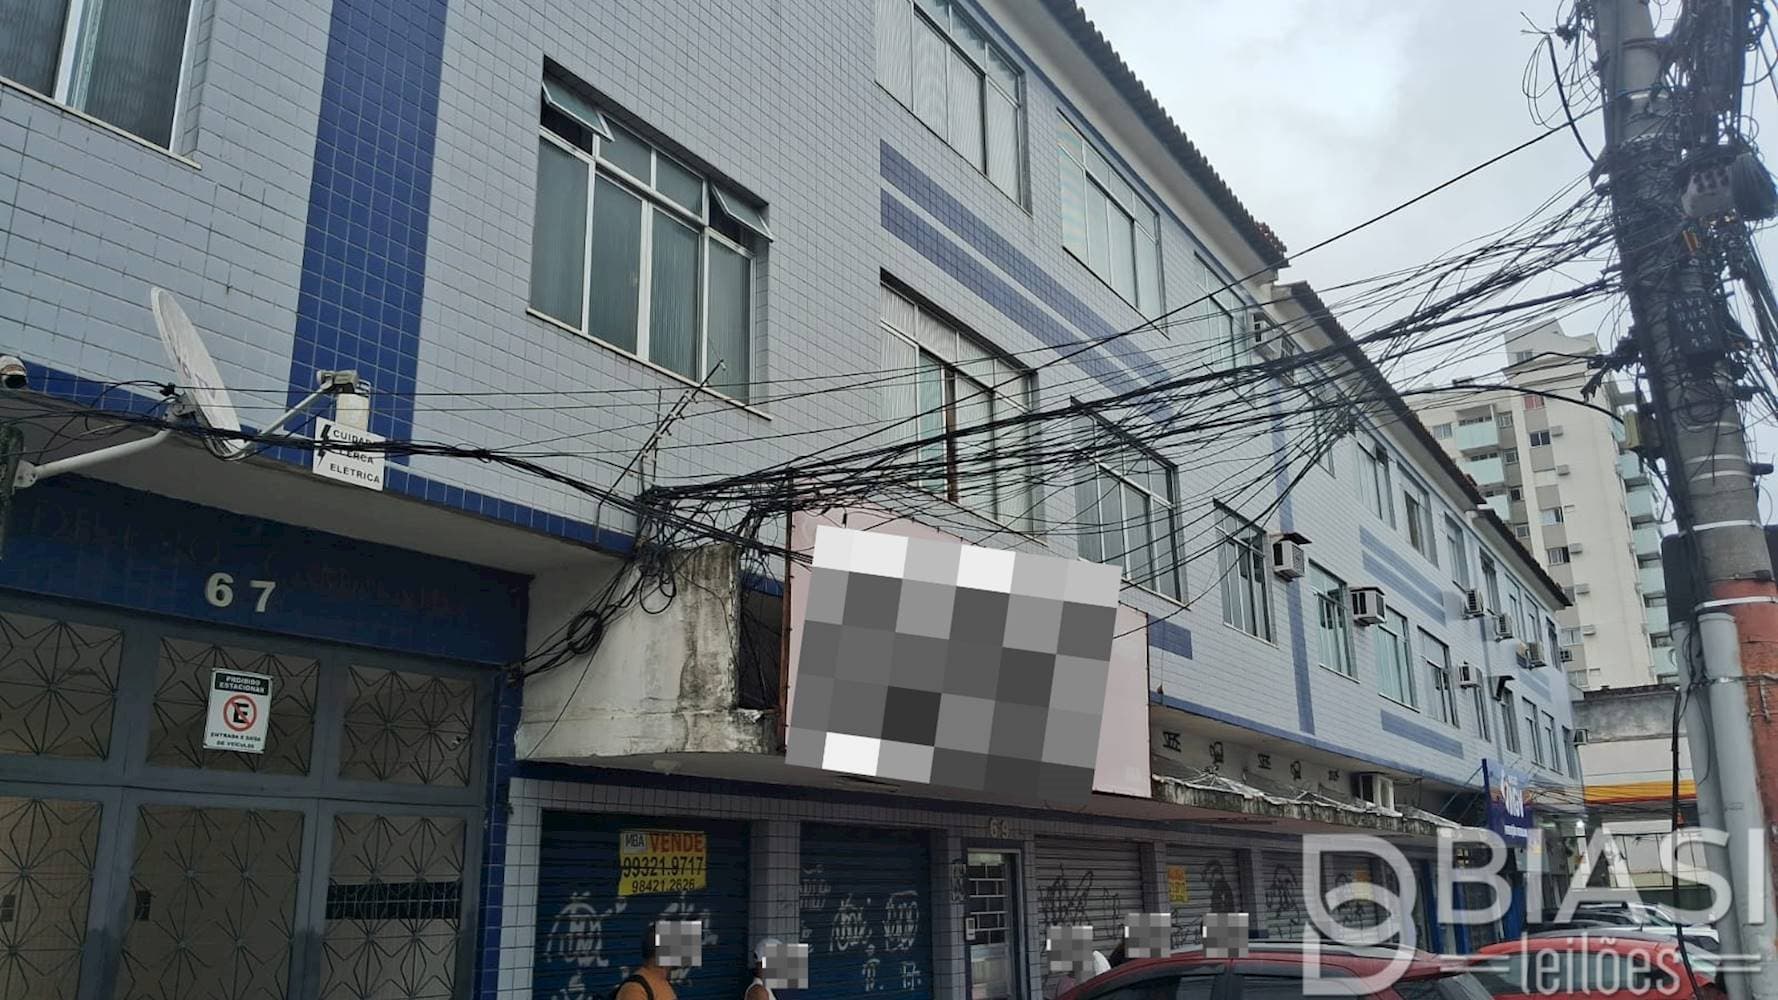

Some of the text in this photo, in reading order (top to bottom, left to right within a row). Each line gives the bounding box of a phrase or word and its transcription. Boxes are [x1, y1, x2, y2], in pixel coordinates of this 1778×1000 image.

[219, 682, 265, 693] ESTACIONAR
[226, 676, 261, 687] PROIBIDO
[649, 832, 704, 853] VENDE
[623, 856, 704, 878] 99321.9717
